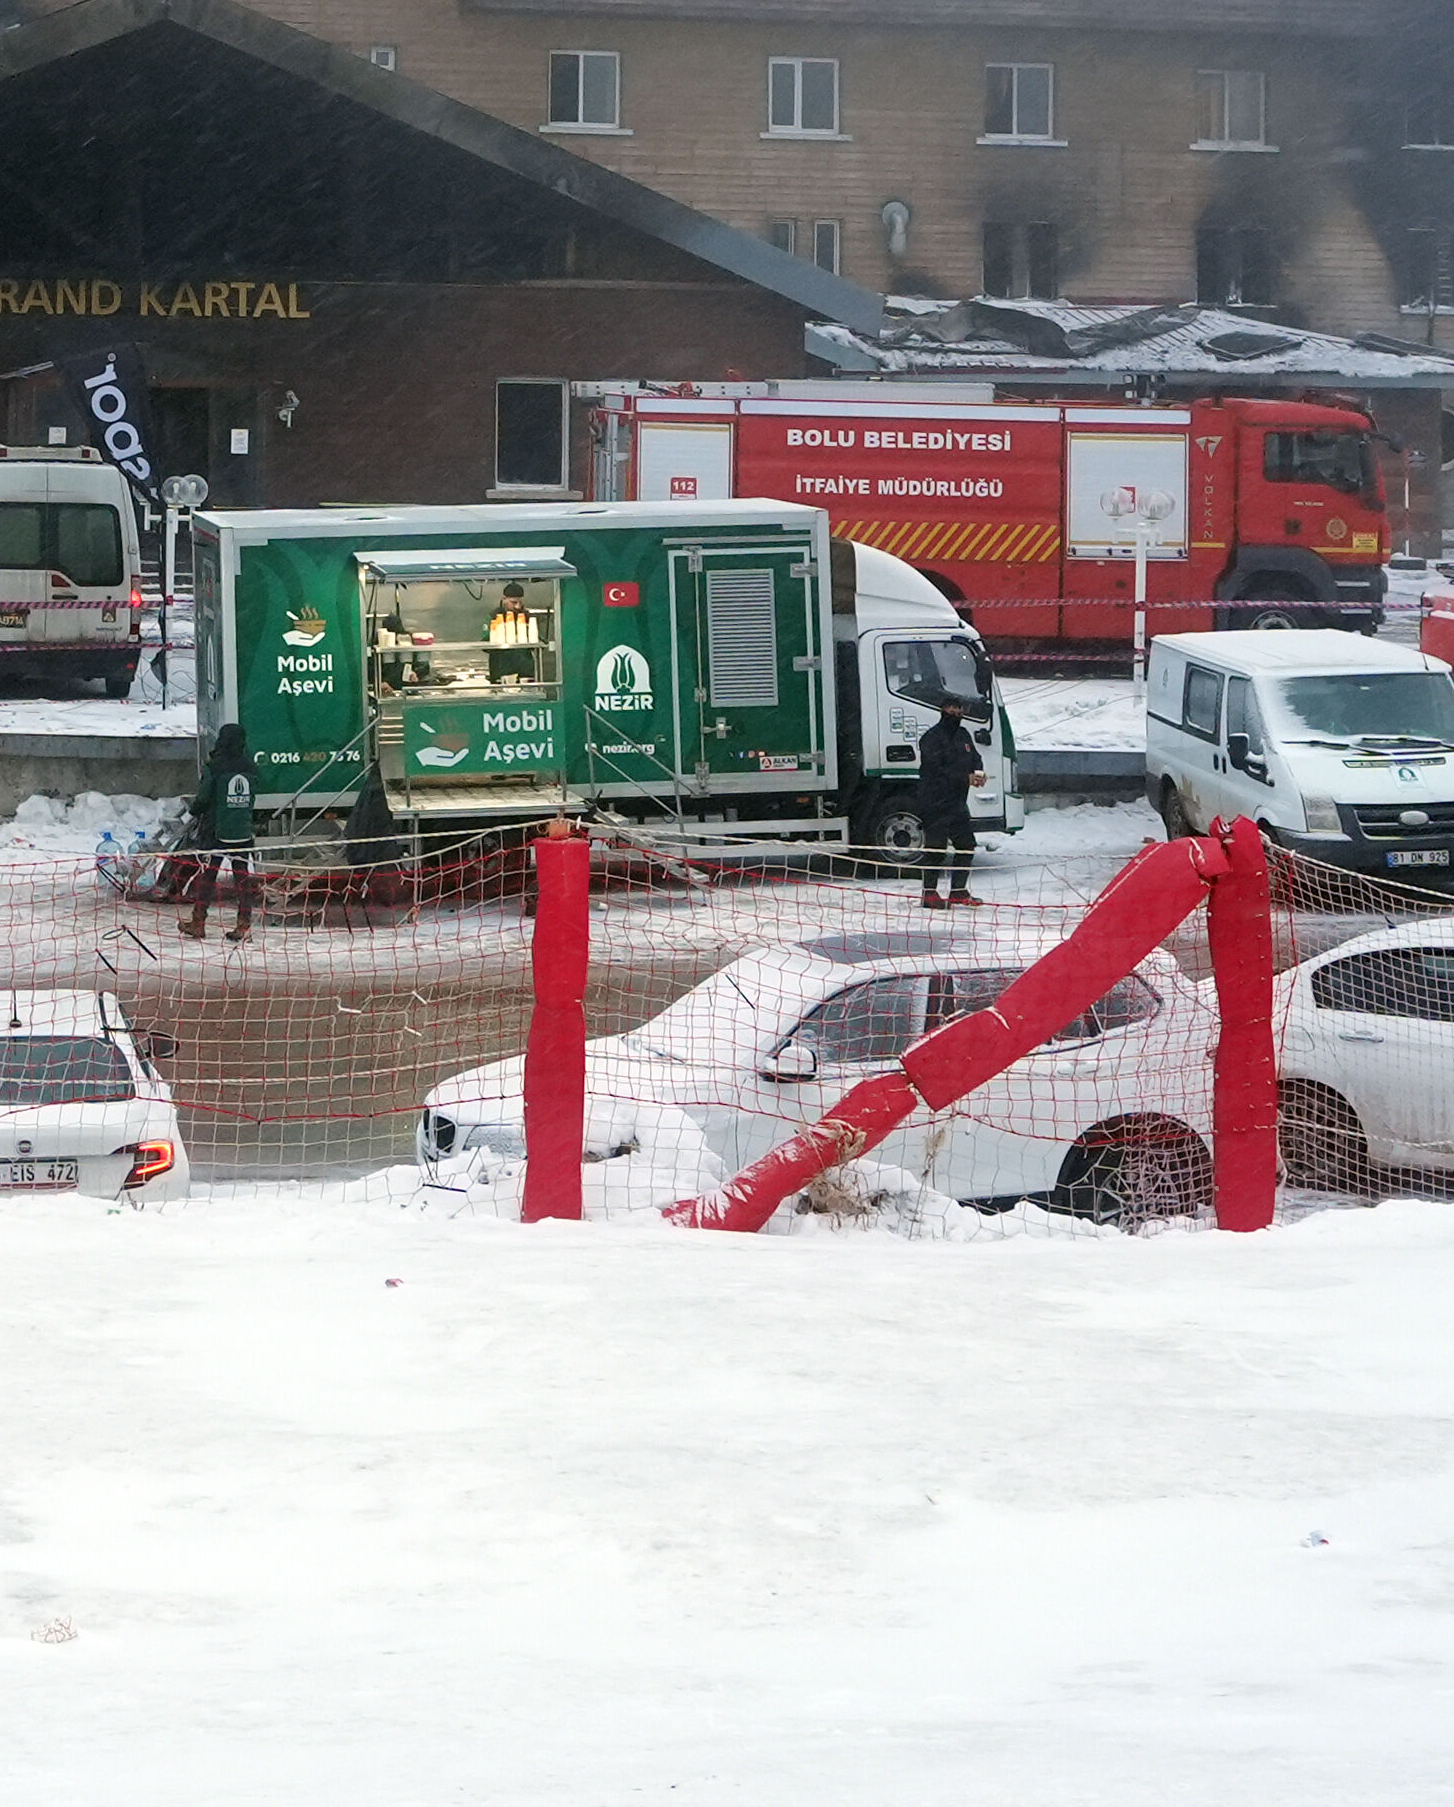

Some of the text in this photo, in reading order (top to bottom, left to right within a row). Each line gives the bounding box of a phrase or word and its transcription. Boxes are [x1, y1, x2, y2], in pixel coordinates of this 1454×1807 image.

[140, 282, 311, 319] KARTAL
[787, 429, 1012, 451] BOLU BELEDİYESİ
[673, 481, 694, 491] 112
[795, 474, 1004, 497] İTFAİYE MÜDÜRLÜĞÜ
[1203, 474, 1215, 539] VOLKAN
[277, 654, 333, 672] Mobil
[277, 676, 334, 696] Aşevi
[483, 709, 553, 733] Mobil
[271, 752, 300, 763] 0216
[346, 750, 361, 762] 76
[483, 737, 554, 763] Aşevi
